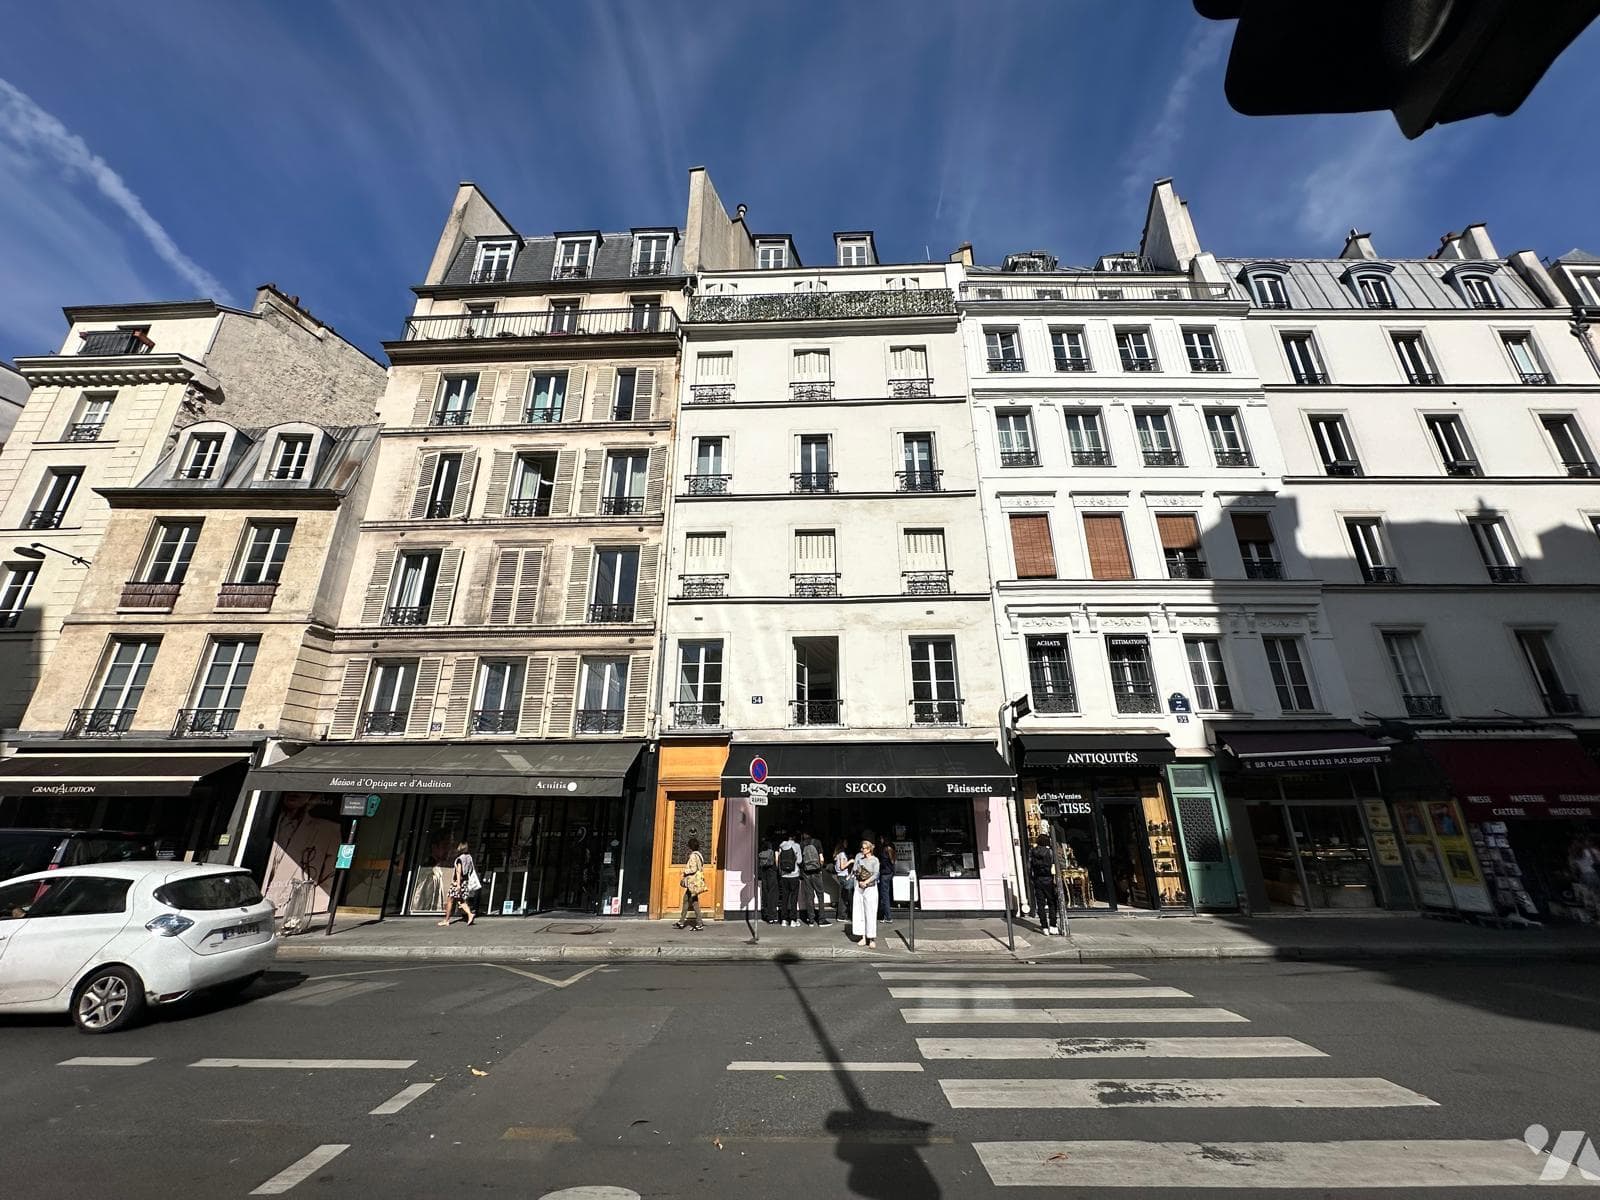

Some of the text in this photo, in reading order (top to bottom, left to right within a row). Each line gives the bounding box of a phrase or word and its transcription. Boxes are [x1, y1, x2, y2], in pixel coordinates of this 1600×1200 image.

[752, 696, 763, 704] 54
[1067, 751, 1138, 764] ANTIQUITÉS
[329, 778, 355, 786] Maison
[357, 778, 398, 789] d'Optique
[409, 780, 452, 788] d'Audition
[845, 782, 887, 793] SECCO
[947, 783, 993, 793] Pâtisserie
[740, 783, 797, 796] Bngerie
